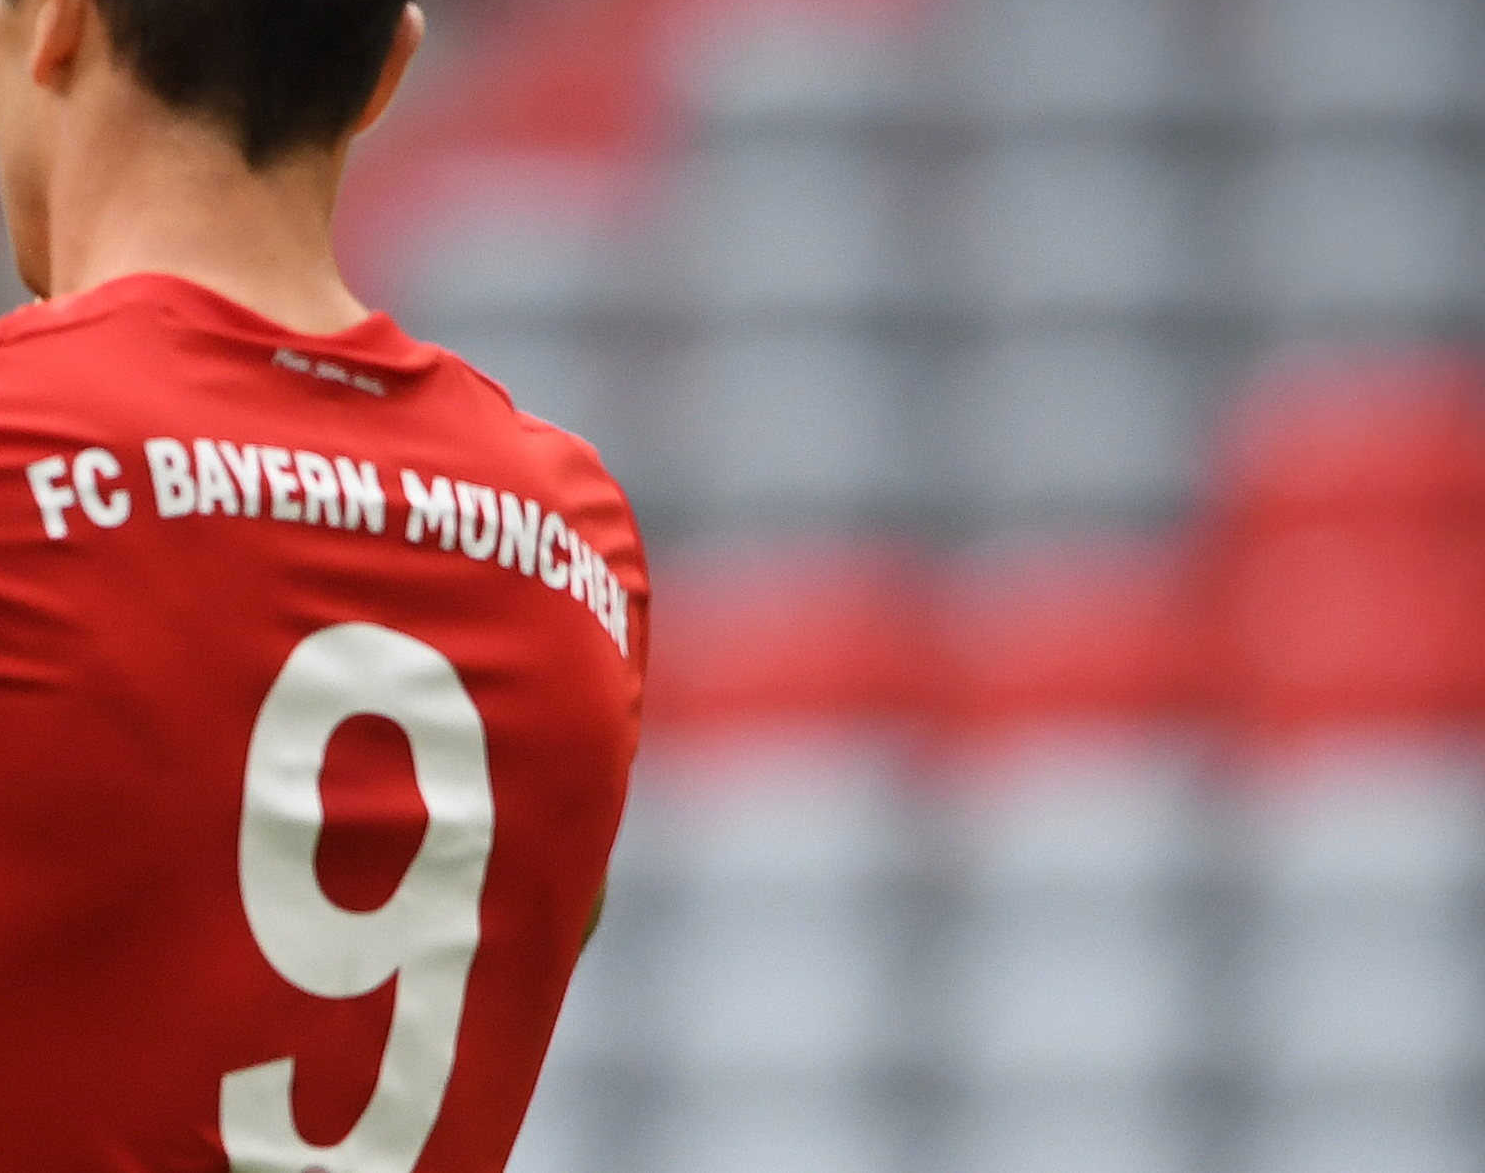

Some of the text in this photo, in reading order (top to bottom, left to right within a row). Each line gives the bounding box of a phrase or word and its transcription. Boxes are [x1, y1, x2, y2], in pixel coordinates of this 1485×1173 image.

[25, 436, 630, 660] FC BAYERN MÜNCHEN
[218, 621, 495, 1173] 9
